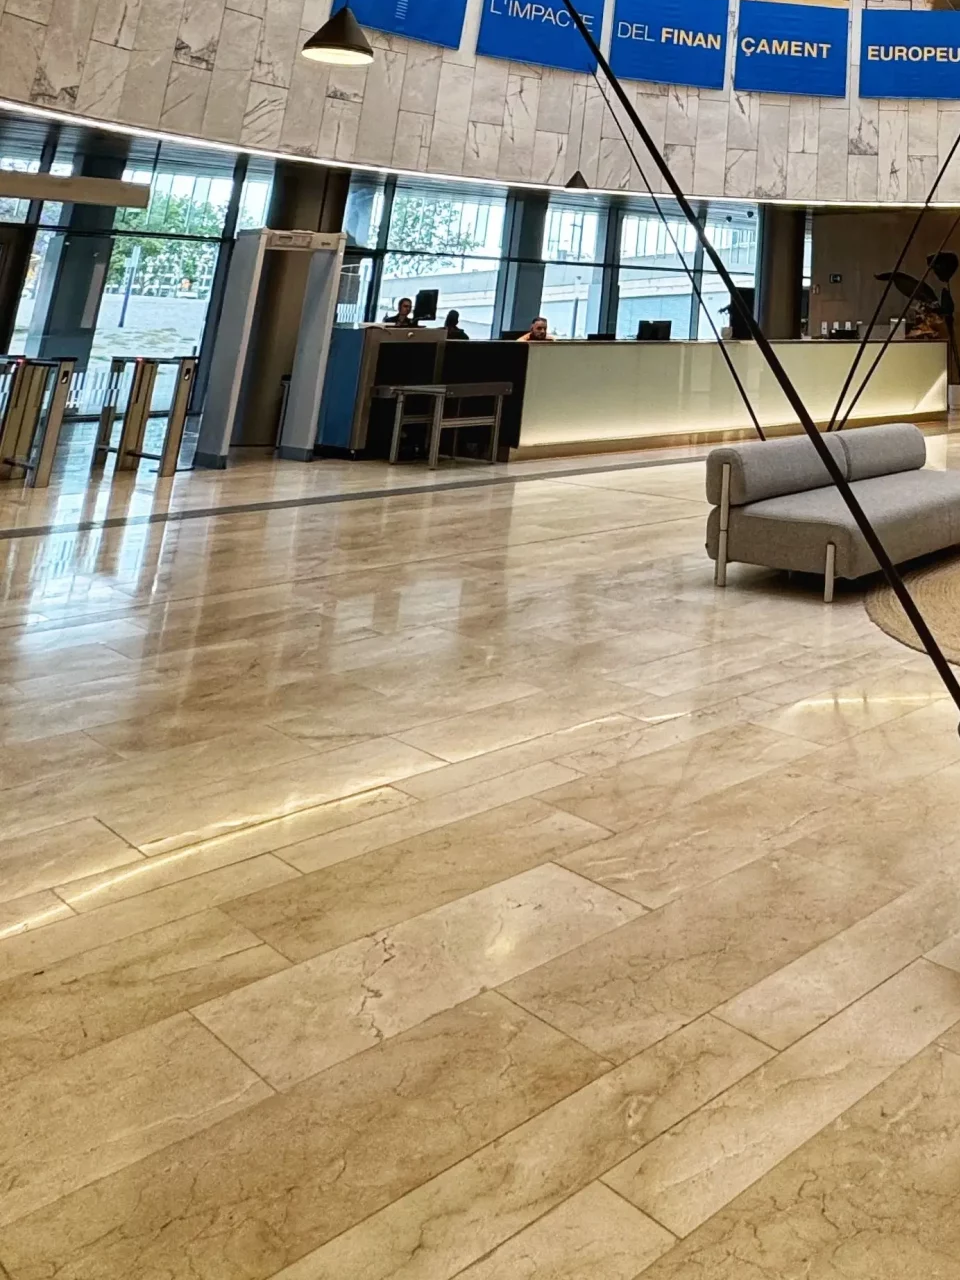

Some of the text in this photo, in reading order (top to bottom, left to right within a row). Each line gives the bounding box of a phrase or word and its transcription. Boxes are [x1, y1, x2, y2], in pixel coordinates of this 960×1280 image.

[617, 21, 655, 42] DEL
[661, 27, 722, 51] FINAN
[740, 36, 832, 59] ÇAMENT
